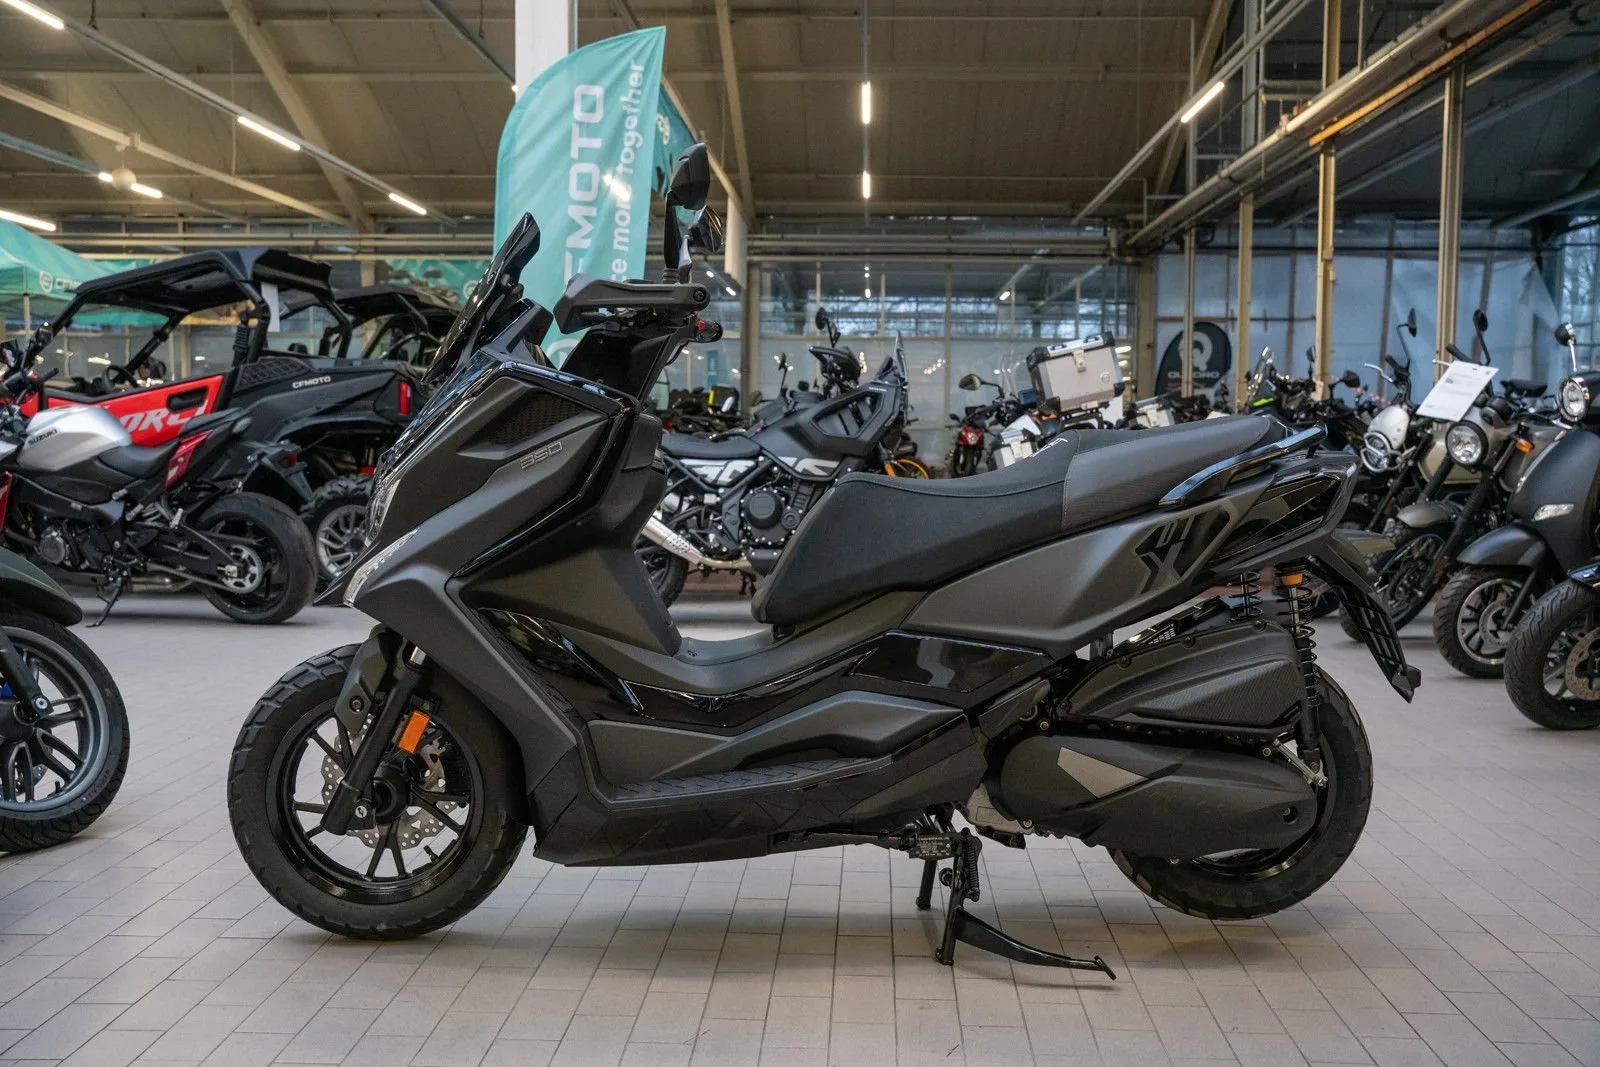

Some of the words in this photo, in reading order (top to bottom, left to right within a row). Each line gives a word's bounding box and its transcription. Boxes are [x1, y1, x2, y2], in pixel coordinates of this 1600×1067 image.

[616, 60, 645, 176] together
[292, 375, 331, 389] CFMOTO
[28, 428, 58, 445] SUZUKI
[520, 441, 562, 469] 350
